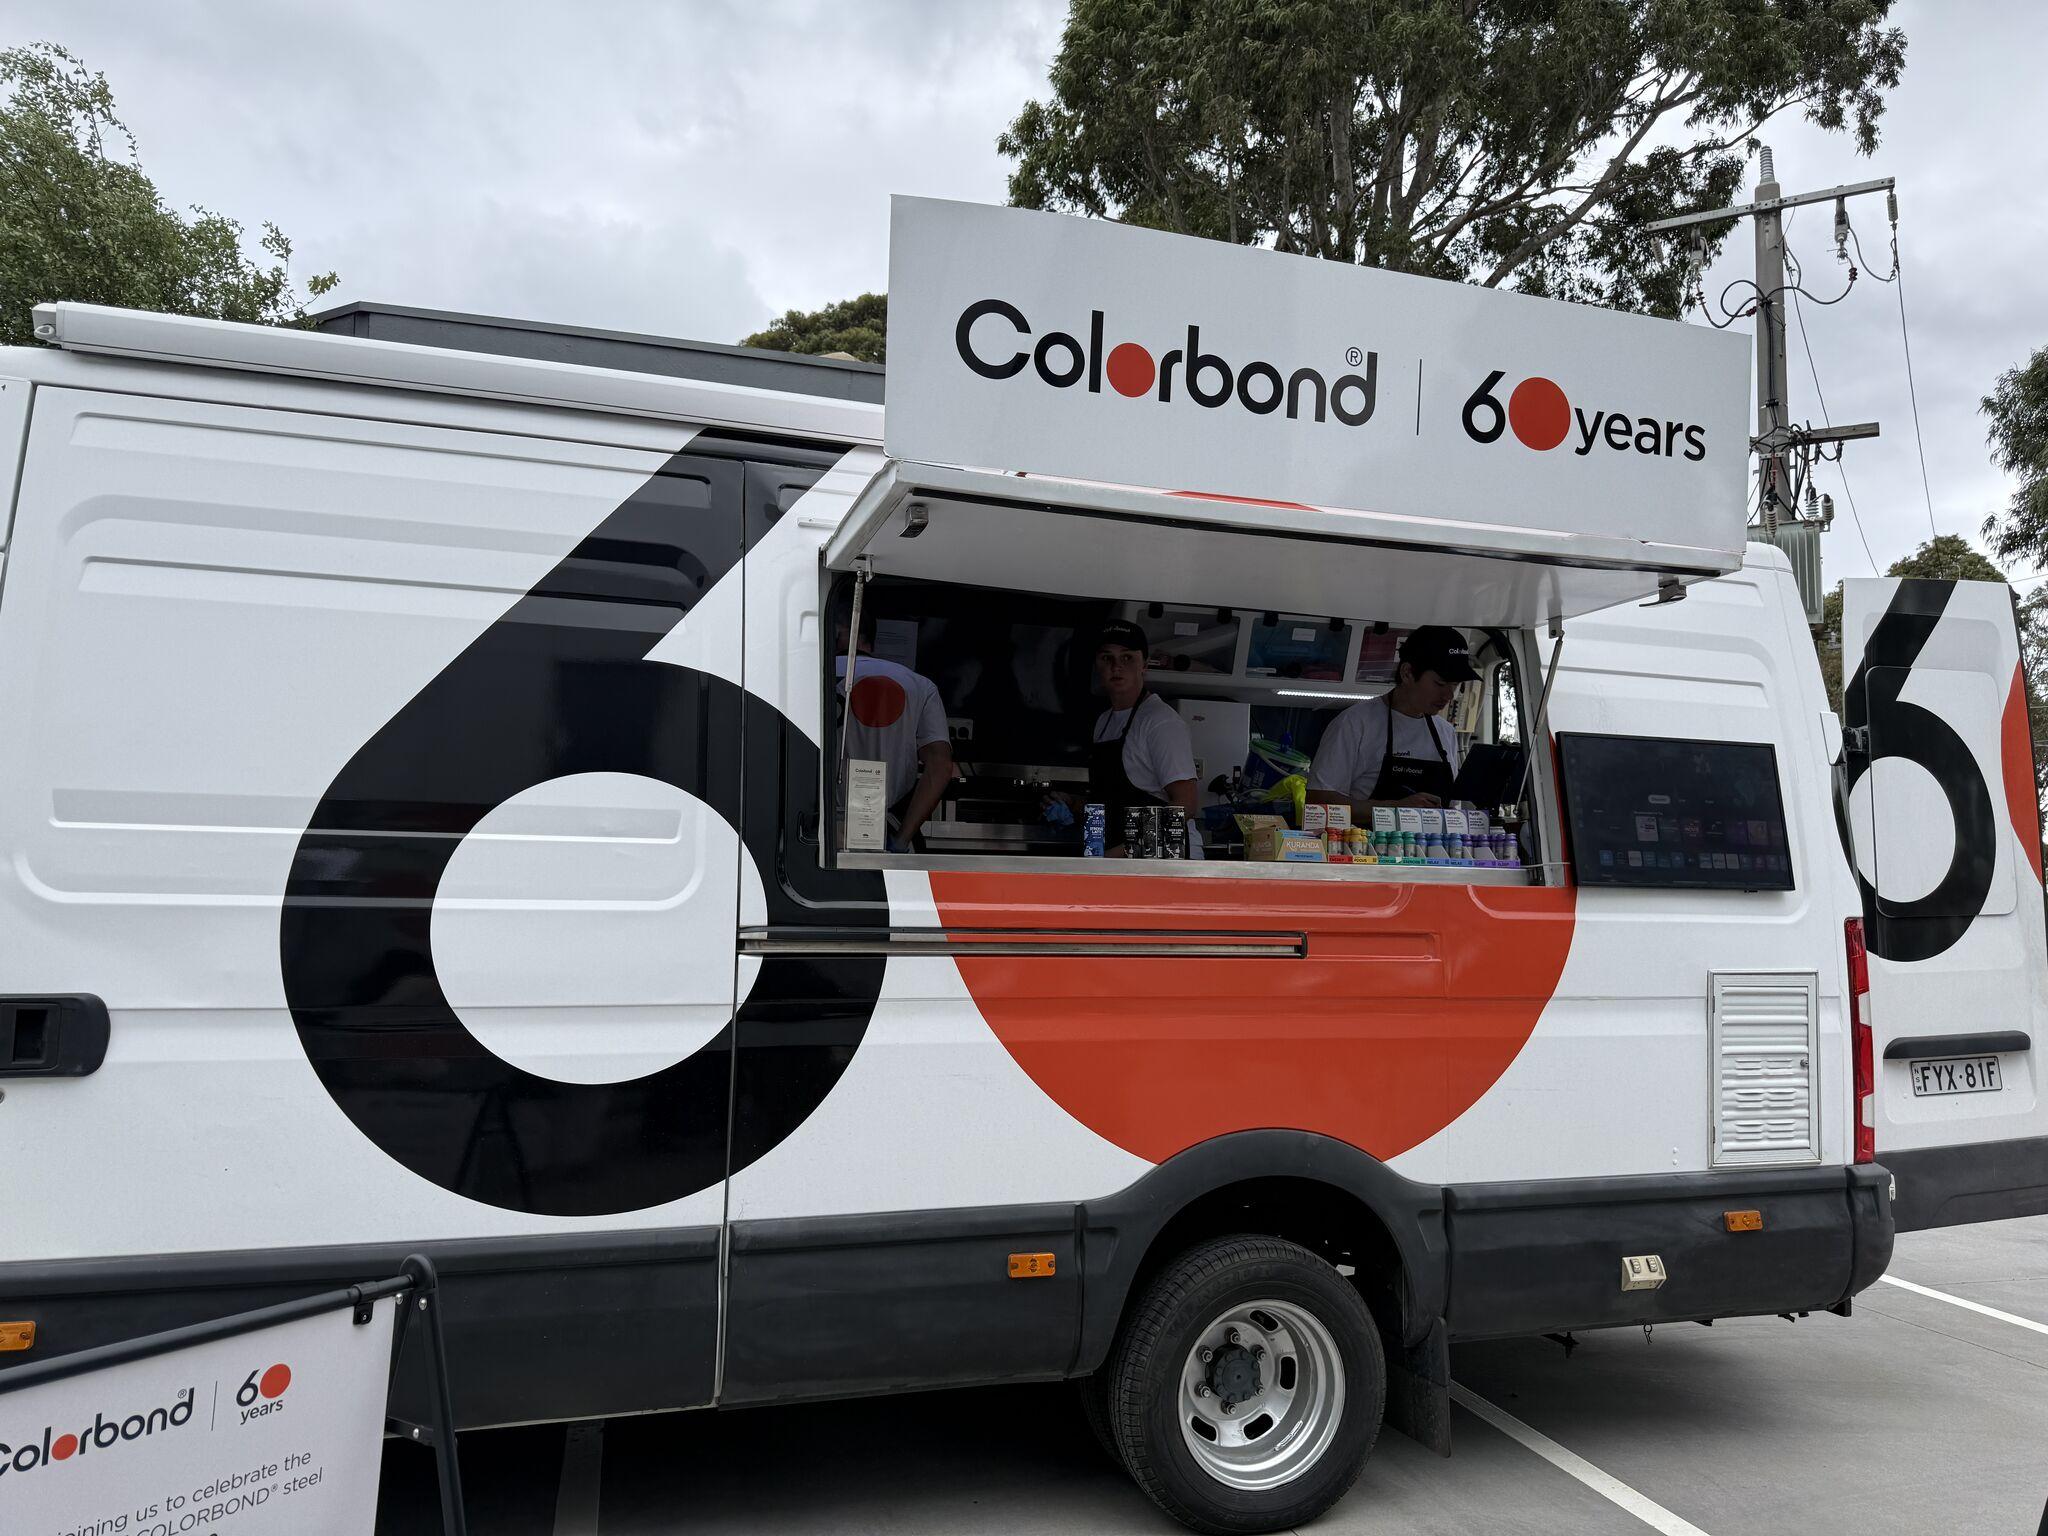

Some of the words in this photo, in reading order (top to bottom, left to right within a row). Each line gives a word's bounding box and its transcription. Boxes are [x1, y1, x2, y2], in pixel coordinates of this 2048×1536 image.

[1286, 841, 1320, 850] KURANDA
[239, 1399, 284, 1426] years
[0, 1387, 194, 1477] olorbond®
[57, 1513, 128, 1536] ining
[136, 1503, 158, 1522] us
[166, 1496, 185, 1512] to
[192, 1464, 278, 1500] celebrate
[284, 1452, 311, 1471] the
[282, 1467, 323, 1495] steel
